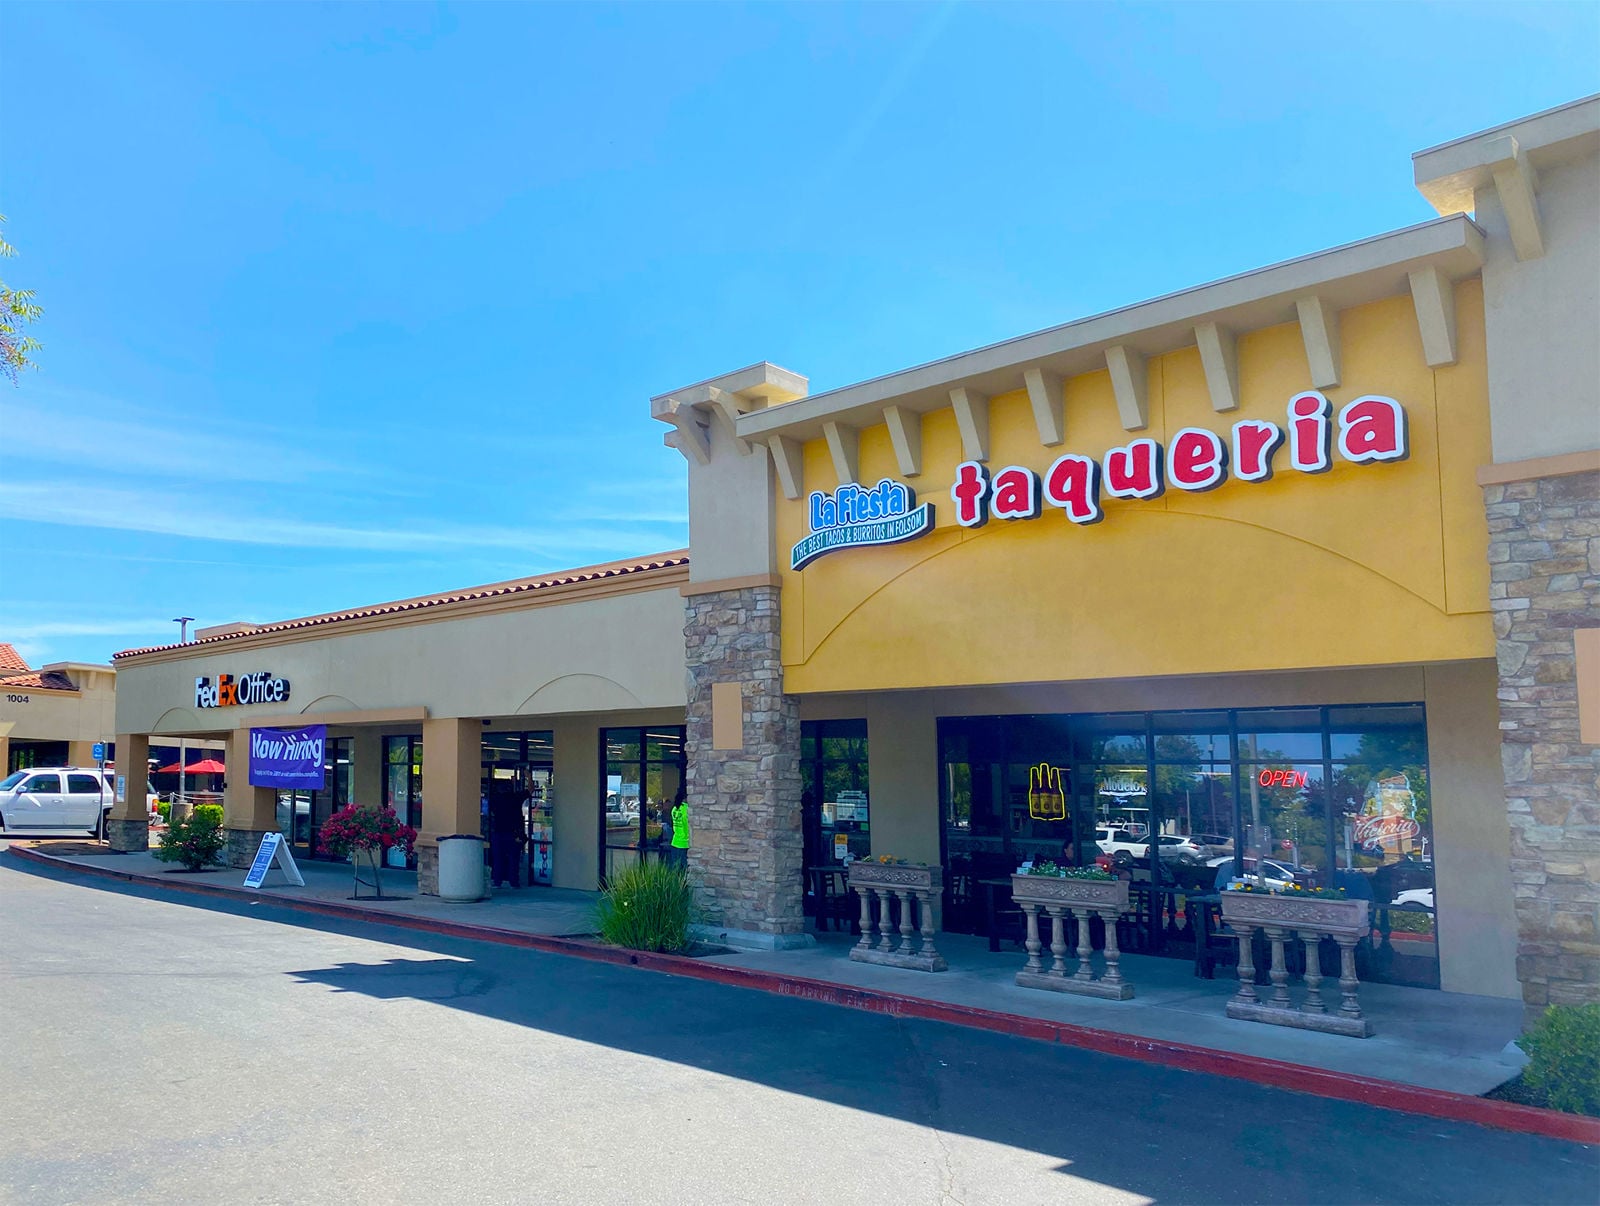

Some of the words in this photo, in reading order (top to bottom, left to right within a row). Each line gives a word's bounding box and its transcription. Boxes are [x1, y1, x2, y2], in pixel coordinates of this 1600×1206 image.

[952, 391, 1404, 525] taqueria
[794, 544, 808, 560] THE
[808, 532, 824, 551] BEST
[826, 528, 845, 545] TACOS
[846, 529, 852, 541] &
[853, 526, 886, 541] BURRITOS
[886, 522, 895, 538] IN
[895, 513, 921, 536] FOLSOM
[6, 694, 30, 703] 1004
[195, 674, 238, 708] FedEx
[238, 671, 284, 704] Office
[252, 733, 283, 760] Now
[282, 733, 322, 767] Hiring
[1259, 769, 1308, 787] OPEN
[778, 983, 790, 994] NO
